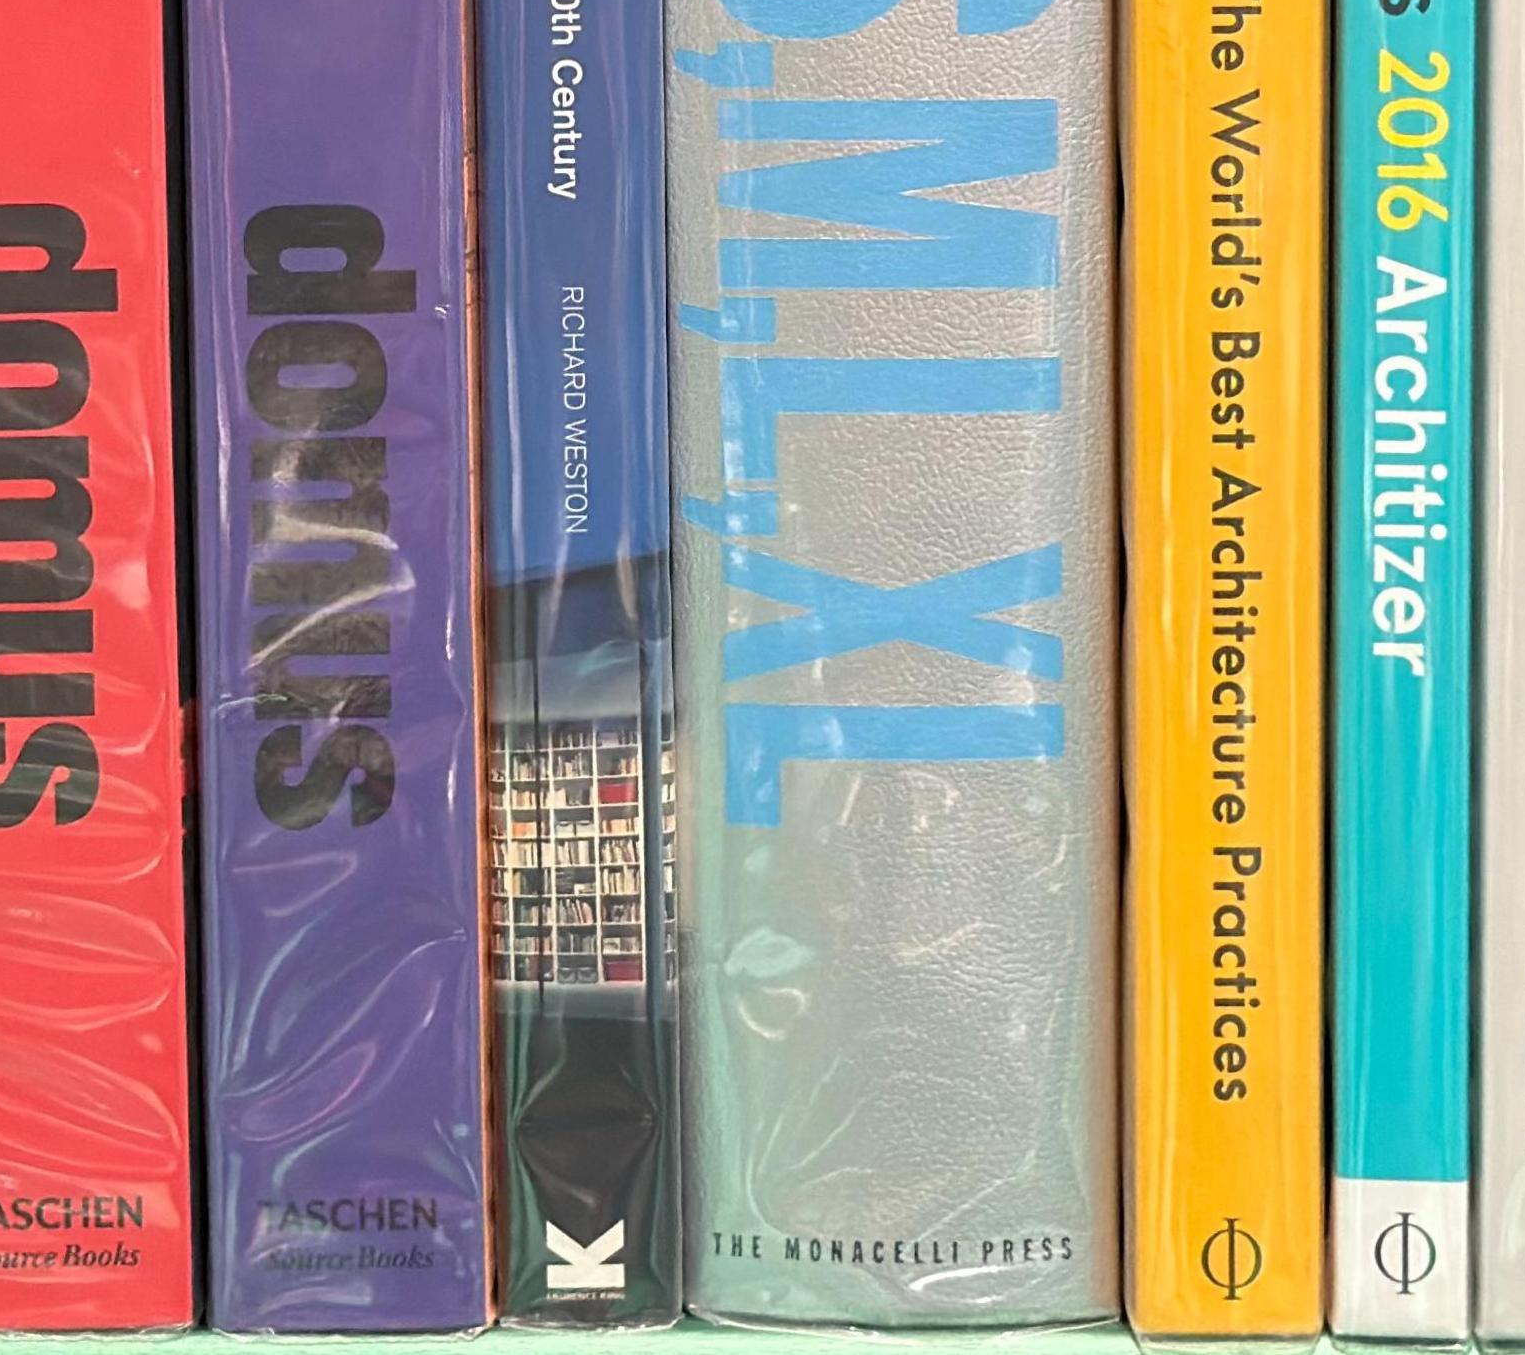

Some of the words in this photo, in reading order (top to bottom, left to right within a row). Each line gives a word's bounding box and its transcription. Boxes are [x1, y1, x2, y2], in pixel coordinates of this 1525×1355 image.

[546, 57, 584, 201] Century
[1209, 89, 1263, 311] World's
[1375, 48, 1452, 233] 2016
[560, 285, 588, 412] RICHARD
[1209, 330, 1261, 450] Best
[243, 203, 417, 832] domus
[562, 418, 589, 535] WESTON
[1371, 255, 1448, 677] Architizer
[1209, 467, 1264, 825] Architecture
[1211, 845, 1263, 1102] Practices
[62, 1242, 141, 1268] Books
[712, 1232, 763, 1259] THE
[785, 1237, 960, 1264] MONACELLI
[981, 1236, 1074, 1263] PRESS
